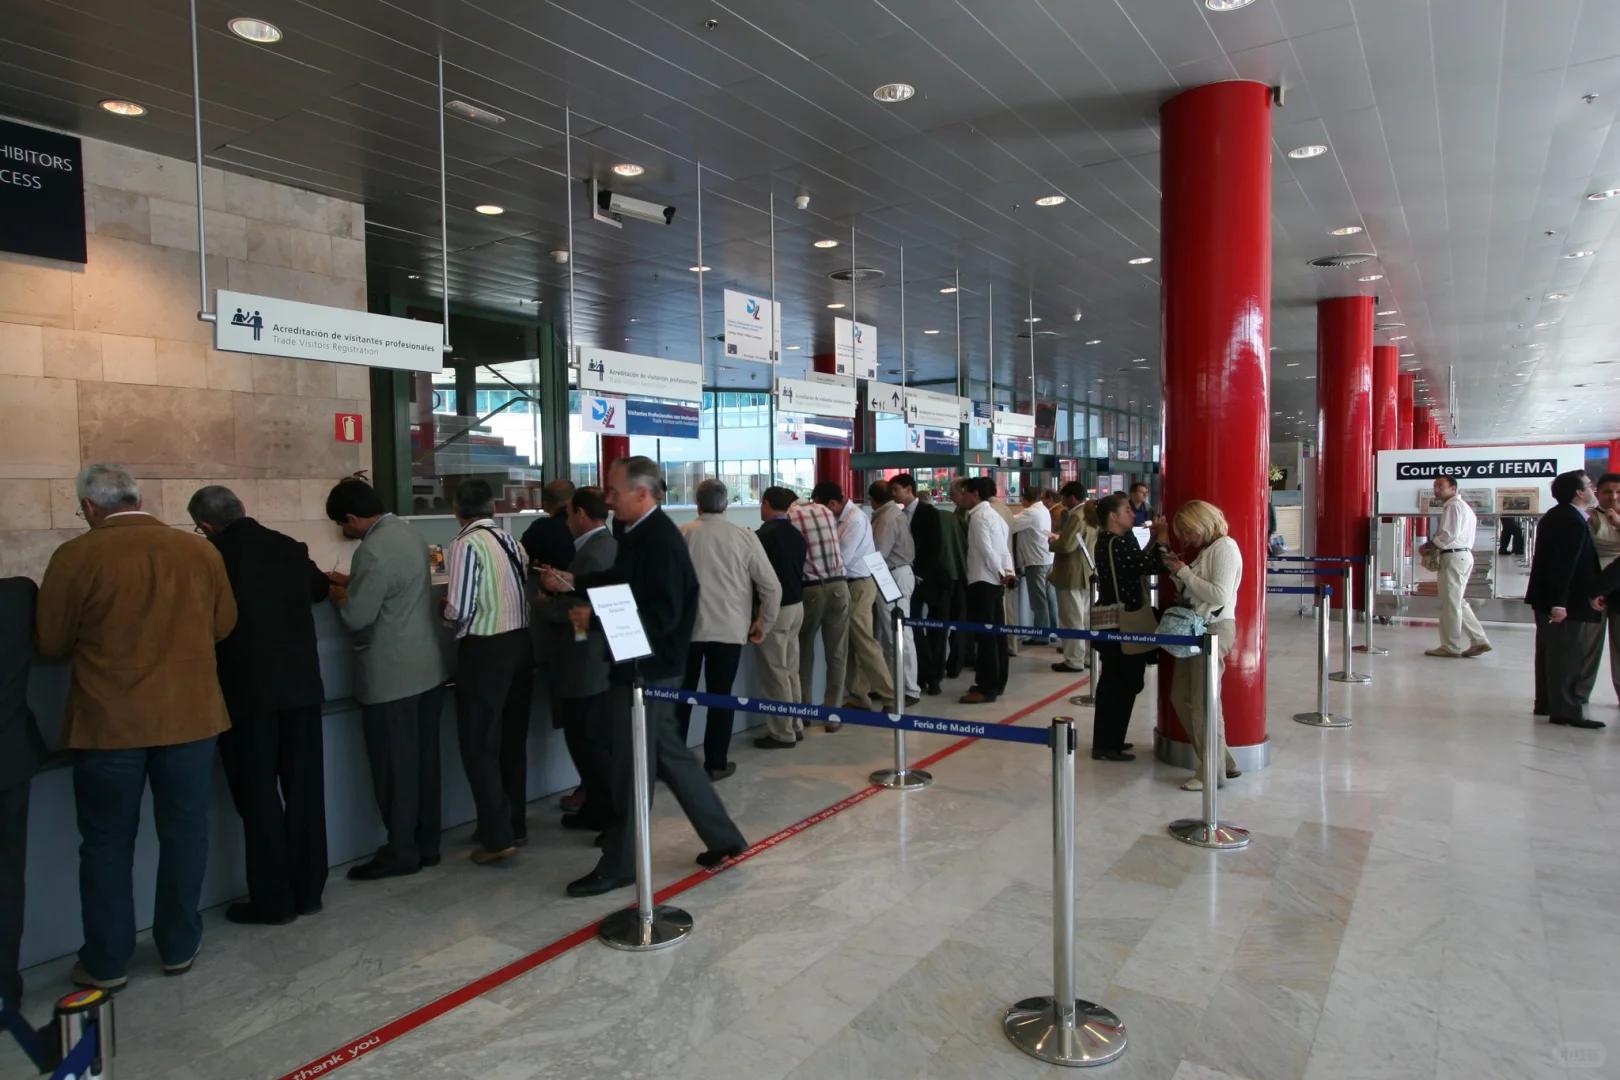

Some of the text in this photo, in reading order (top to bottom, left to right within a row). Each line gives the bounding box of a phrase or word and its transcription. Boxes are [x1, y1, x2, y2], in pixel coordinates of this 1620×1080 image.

[272, 336, 379, 355] Trade Visitors Registration
[273, 324, 435, 352] Acreditación de visitantes profesionales
[1400, 461, 1555, 477] Courtesy of IFEMA
[654, 690, 679, 699] Madrid
[758, 703, 819, 716] Feria de Madrid
[913, 719, 985, 735] Feria de Madrid
[292, 1035, 381, 1080] thank you
